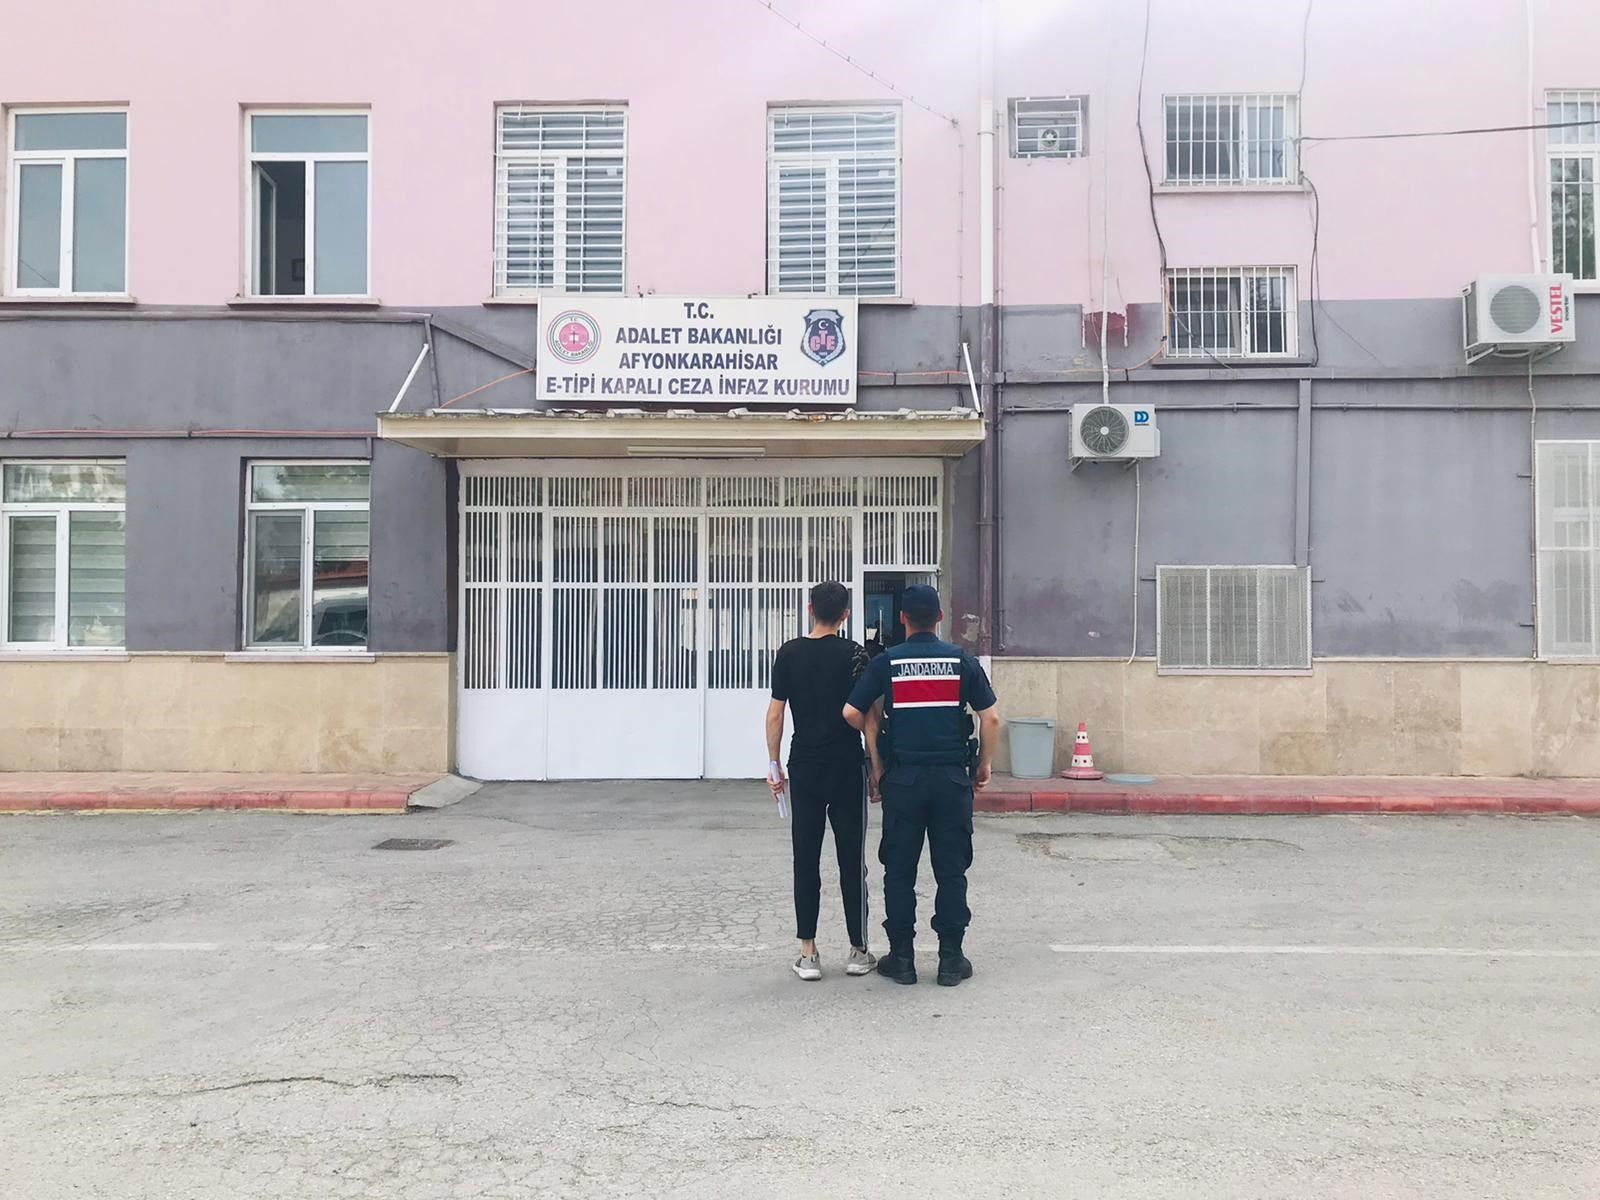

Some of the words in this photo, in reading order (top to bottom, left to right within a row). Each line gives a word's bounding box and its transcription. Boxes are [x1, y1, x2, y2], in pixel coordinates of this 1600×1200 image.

[684, 302, 714, 319] T.C.
[1550, 283, 1563, 334] VESTEL
[616, 327, 682, 344] ADALET
[688, 324, 782, 345] BAKANLIĞI
[619, 349, 778, 370] AFYONKARAHİSAR
[546, 373, 595, 394] E-TİPİ
[601, 377, 662, 395] KAPALI
[668, 378, 713, 395] CEZA
[720, 374, 768, 395] İNFAZ
[774, 379, 850, 396] KURUMU
[898, 663, 954, 676] JANDARMA
